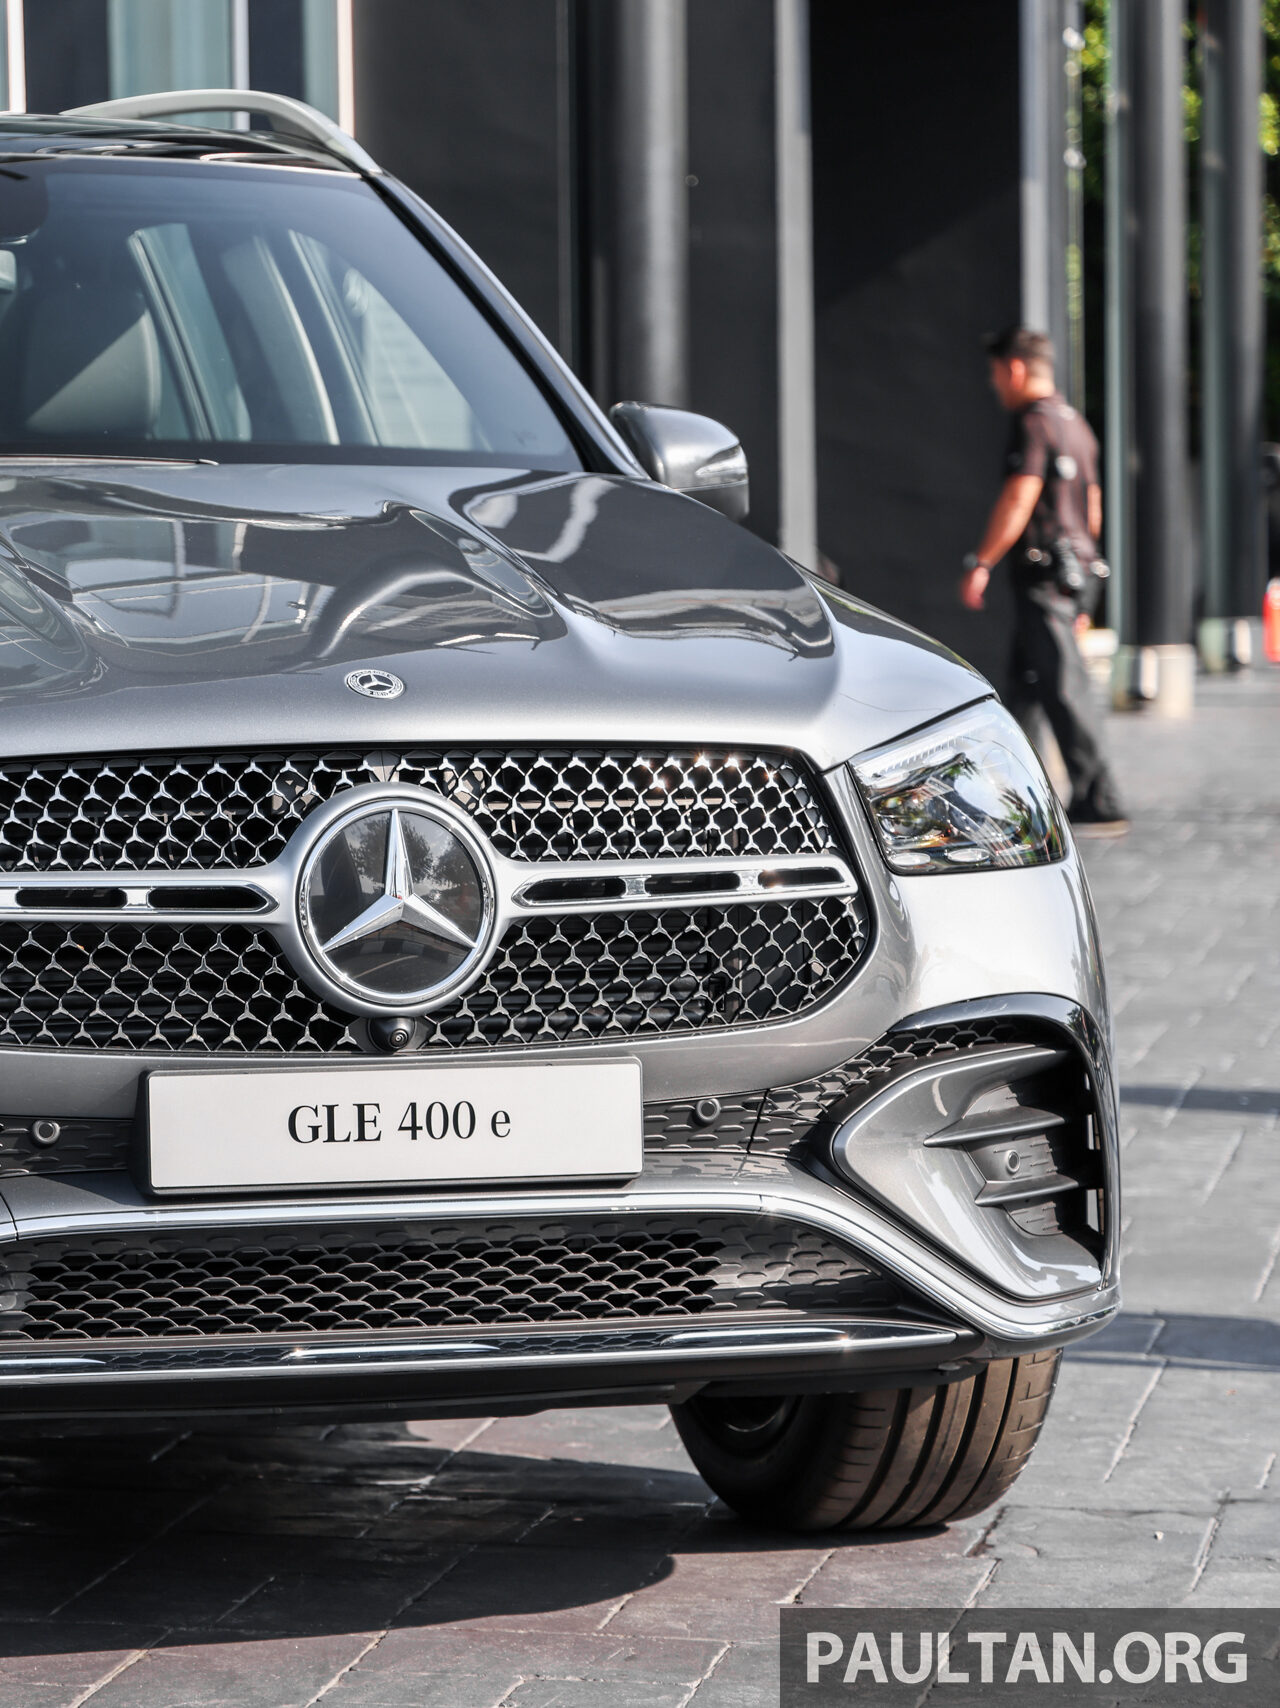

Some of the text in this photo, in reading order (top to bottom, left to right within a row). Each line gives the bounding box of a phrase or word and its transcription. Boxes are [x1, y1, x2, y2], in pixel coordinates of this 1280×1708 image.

[287, 1100, 512, 1144] GLE 400 e
